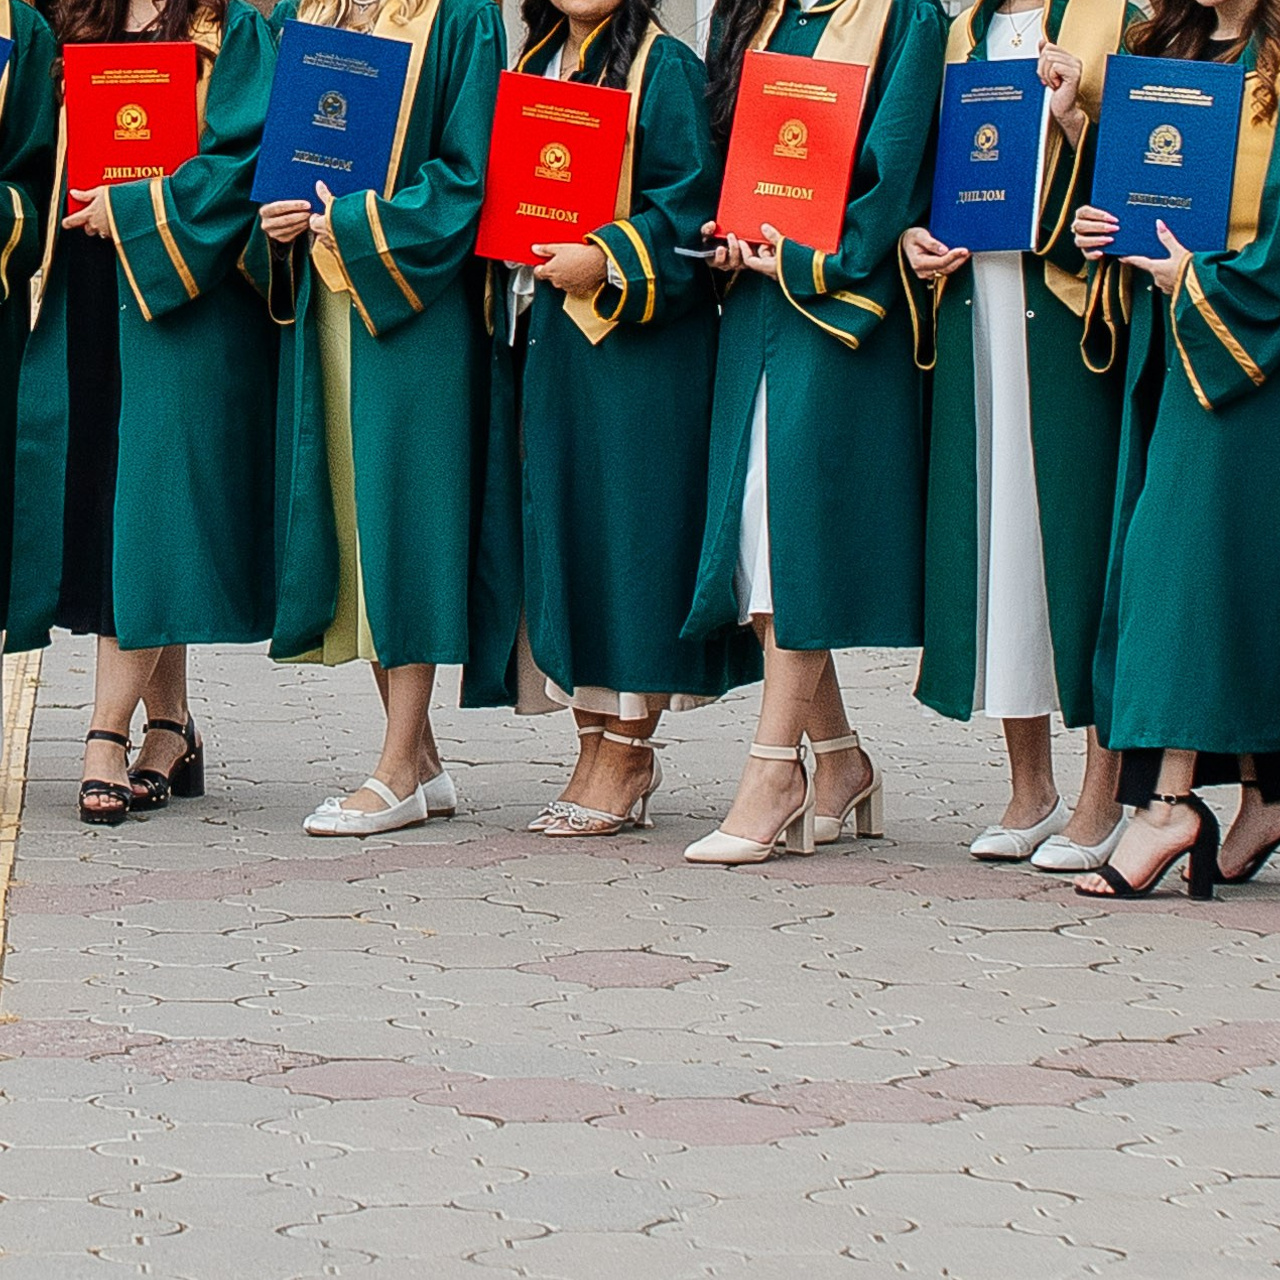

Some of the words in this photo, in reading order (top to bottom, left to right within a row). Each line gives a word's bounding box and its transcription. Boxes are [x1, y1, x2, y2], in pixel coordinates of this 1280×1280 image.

[102, 167, 164, 180] ДИПЛОМ
[753, 181, 814, 201] ДИПЛОМ
[955, 190, 1006, 204] ДИПЛОМ
[516, 201, 579, 224] ДИПЛОМ
